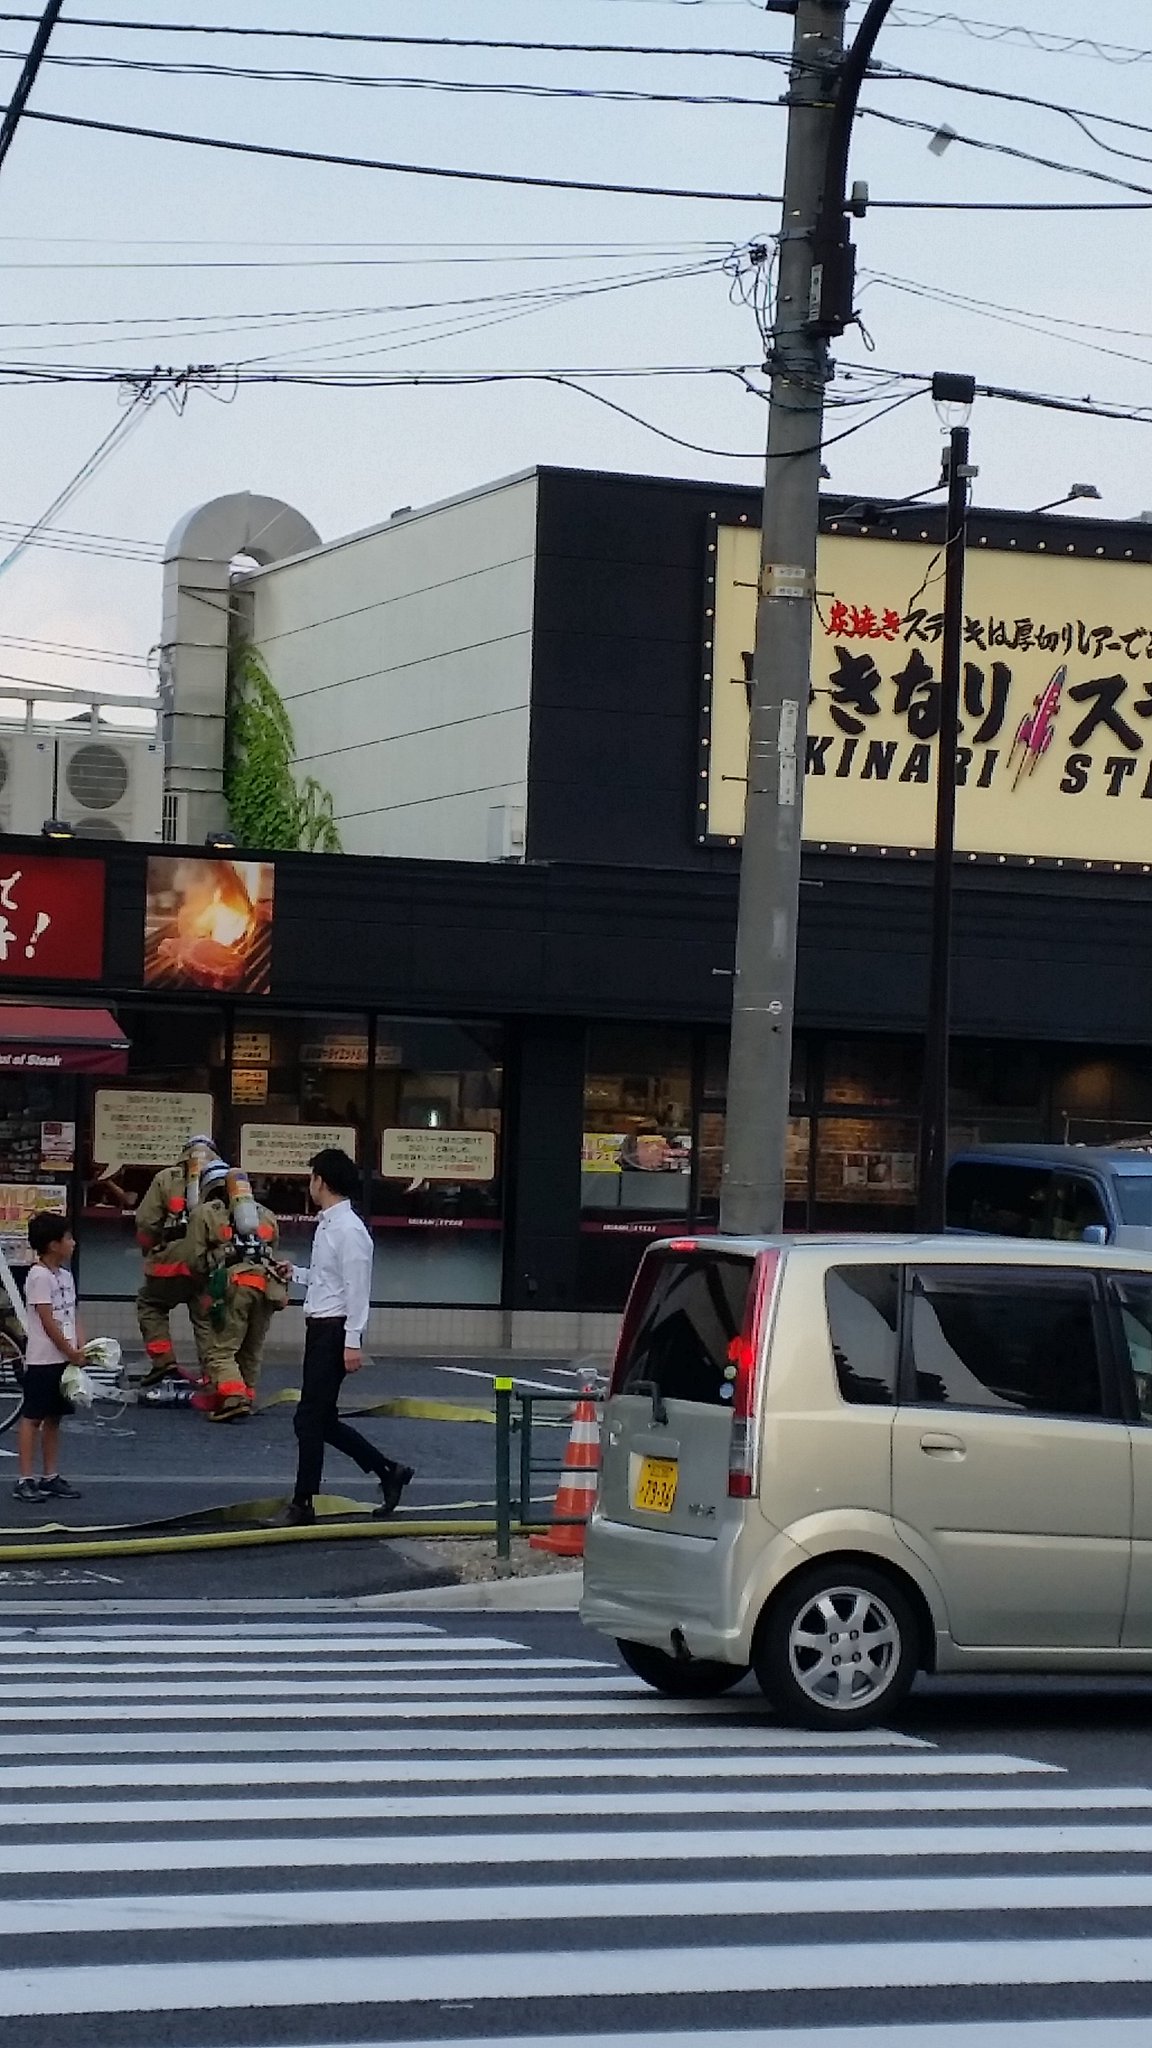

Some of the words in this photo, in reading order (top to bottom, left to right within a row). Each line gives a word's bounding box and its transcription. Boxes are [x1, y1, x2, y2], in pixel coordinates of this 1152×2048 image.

[741, 645, 1012, 744] きなり
[1067, 674, 1152, 751] ス
[805, 736, 1000, 788] KINARI
